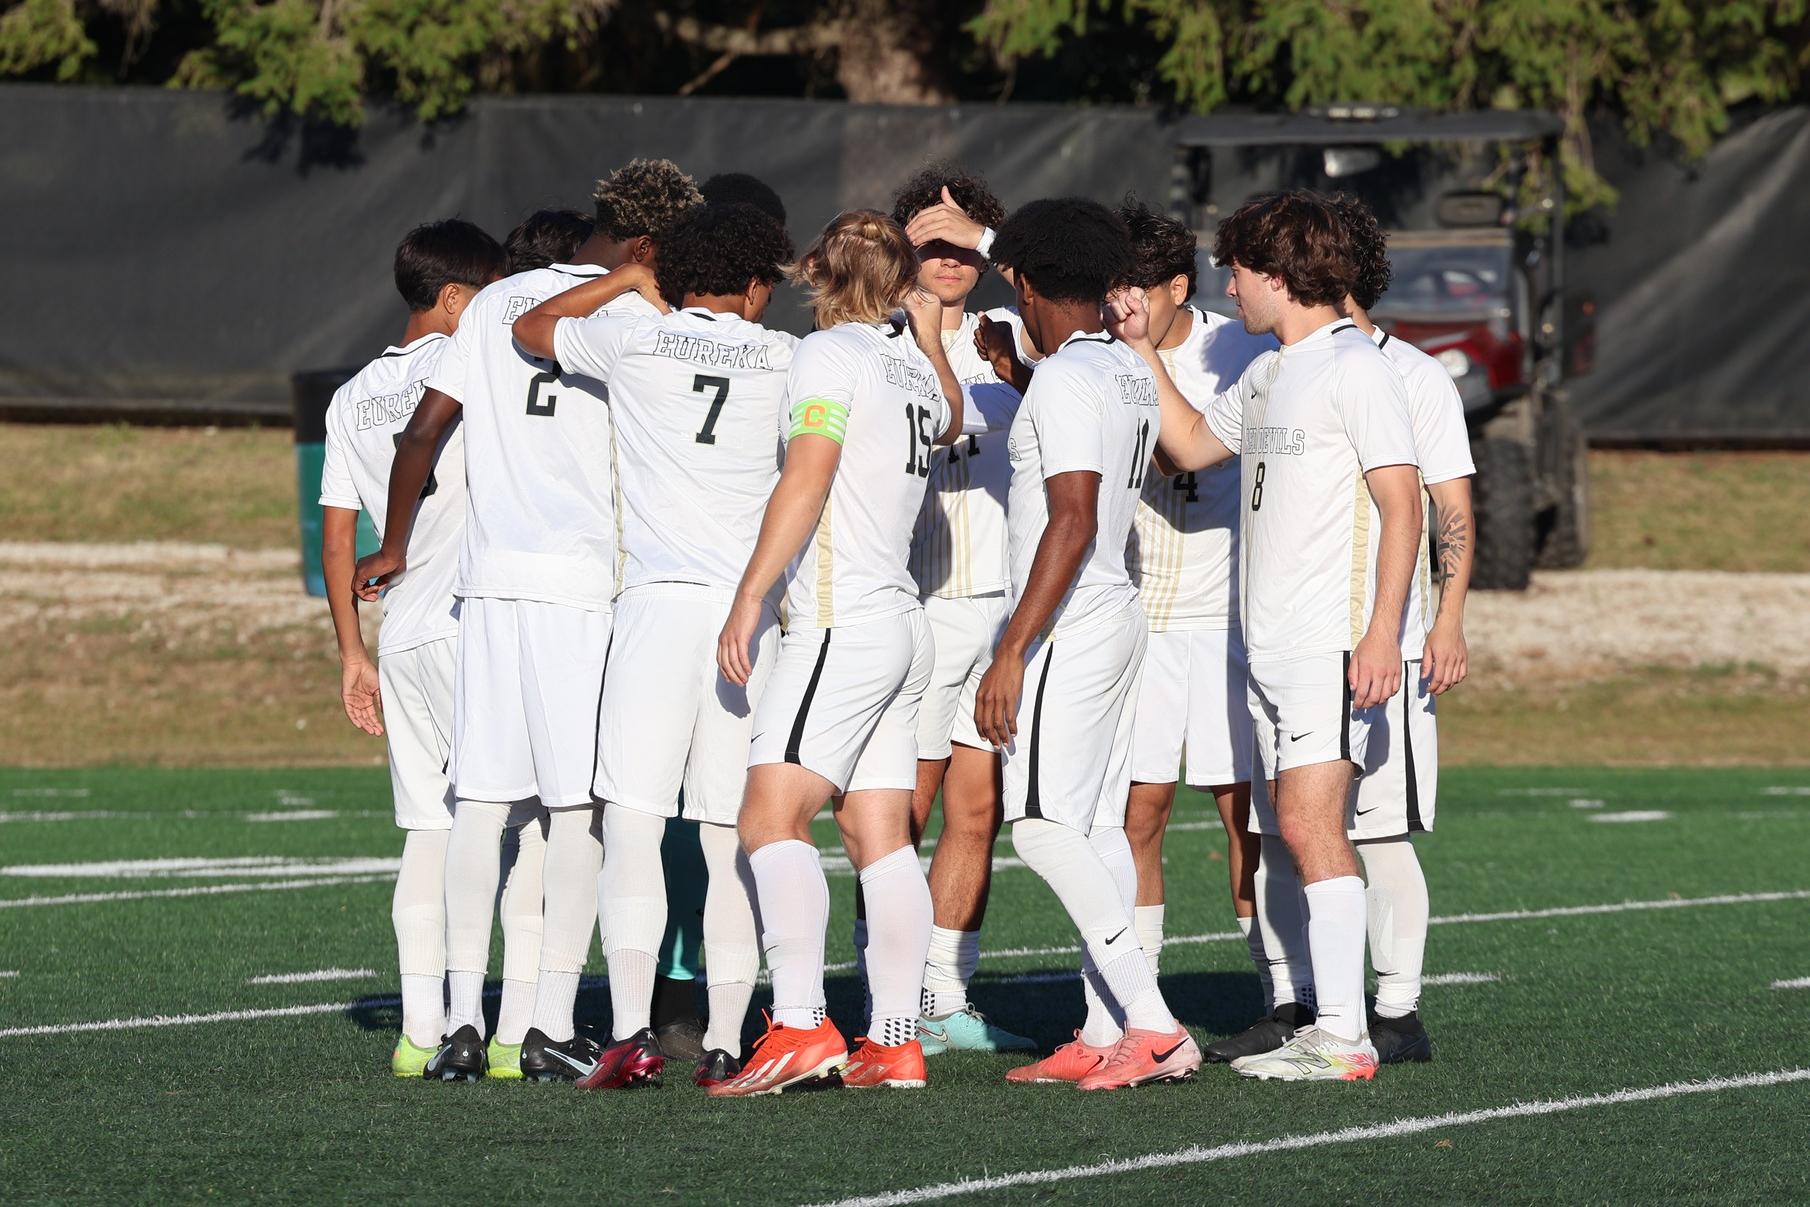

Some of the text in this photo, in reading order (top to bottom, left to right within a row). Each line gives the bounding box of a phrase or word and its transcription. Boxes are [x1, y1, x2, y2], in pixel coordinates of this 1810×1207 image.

[653, 331, 773, 371] EUREKA
[526, 356, 563, 417] 2
[692, 374, 730, 445] 7
[804, 405, 826, 428] C
[905, 402, 932, 478] 15
[1127, 417, 1150, 488] 11
[1173, 471, 1199, 502] 4
[1251, 461, 1266, 512] 8
